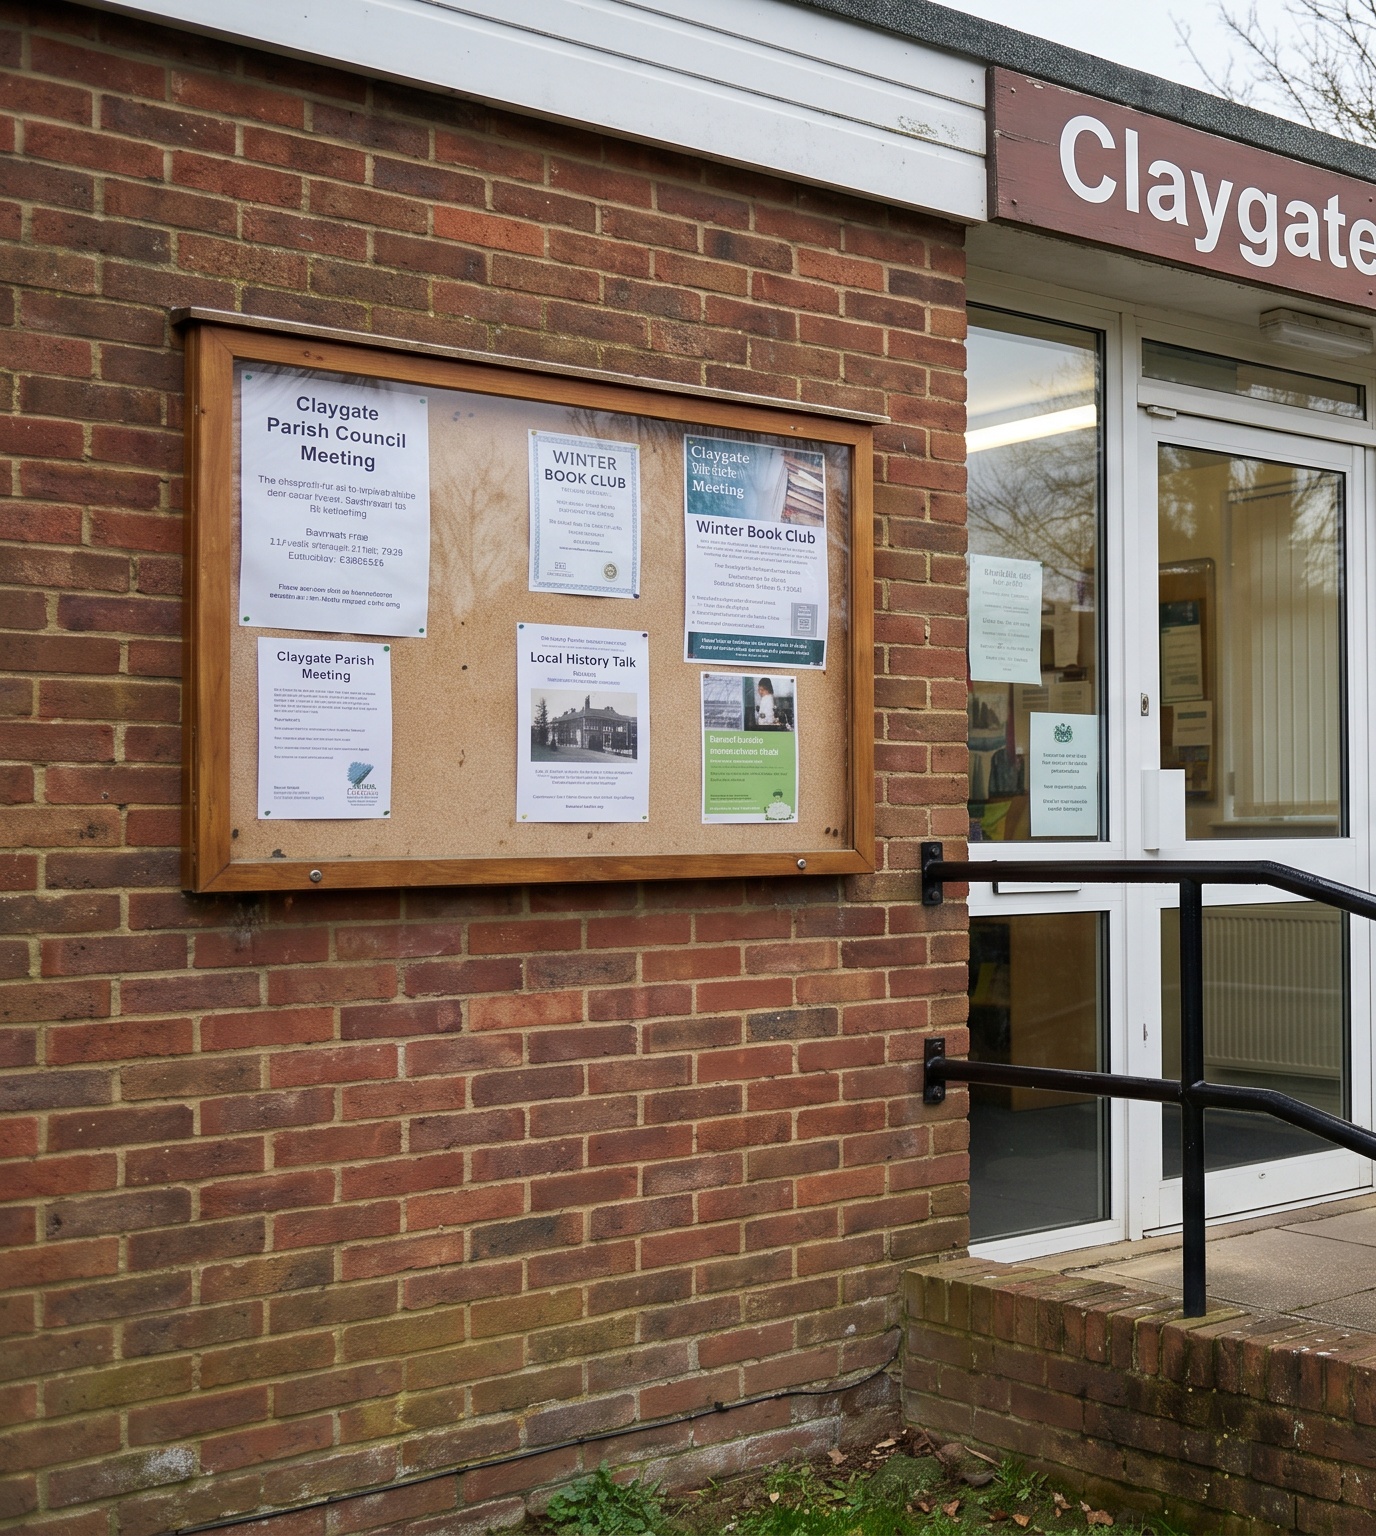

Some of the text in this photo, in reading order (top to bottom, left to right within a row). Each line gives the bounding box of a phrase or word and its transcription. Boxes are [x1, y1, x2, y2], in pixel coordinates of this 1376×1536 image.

[296, 396, 379, 421] Claygate
[267, 416, 406, 448] Parish Council
[301, 445, 375, 472] Meeting
[552, 450, 617, 471] WINTER
[691, 445, 750, 465] Claygate
[258, 474, 276, 485] The
[544, 468, 626, 489] BOOK CLUB
[691, 480, 745, 500] Meeting
[696, 520, 816, 544] Winter Book Club
[277, 651, 375, 666] Claygate Parish
[530, 651, 636, 668] Local History Talk
[302, 668, 351, 683] Meeting
